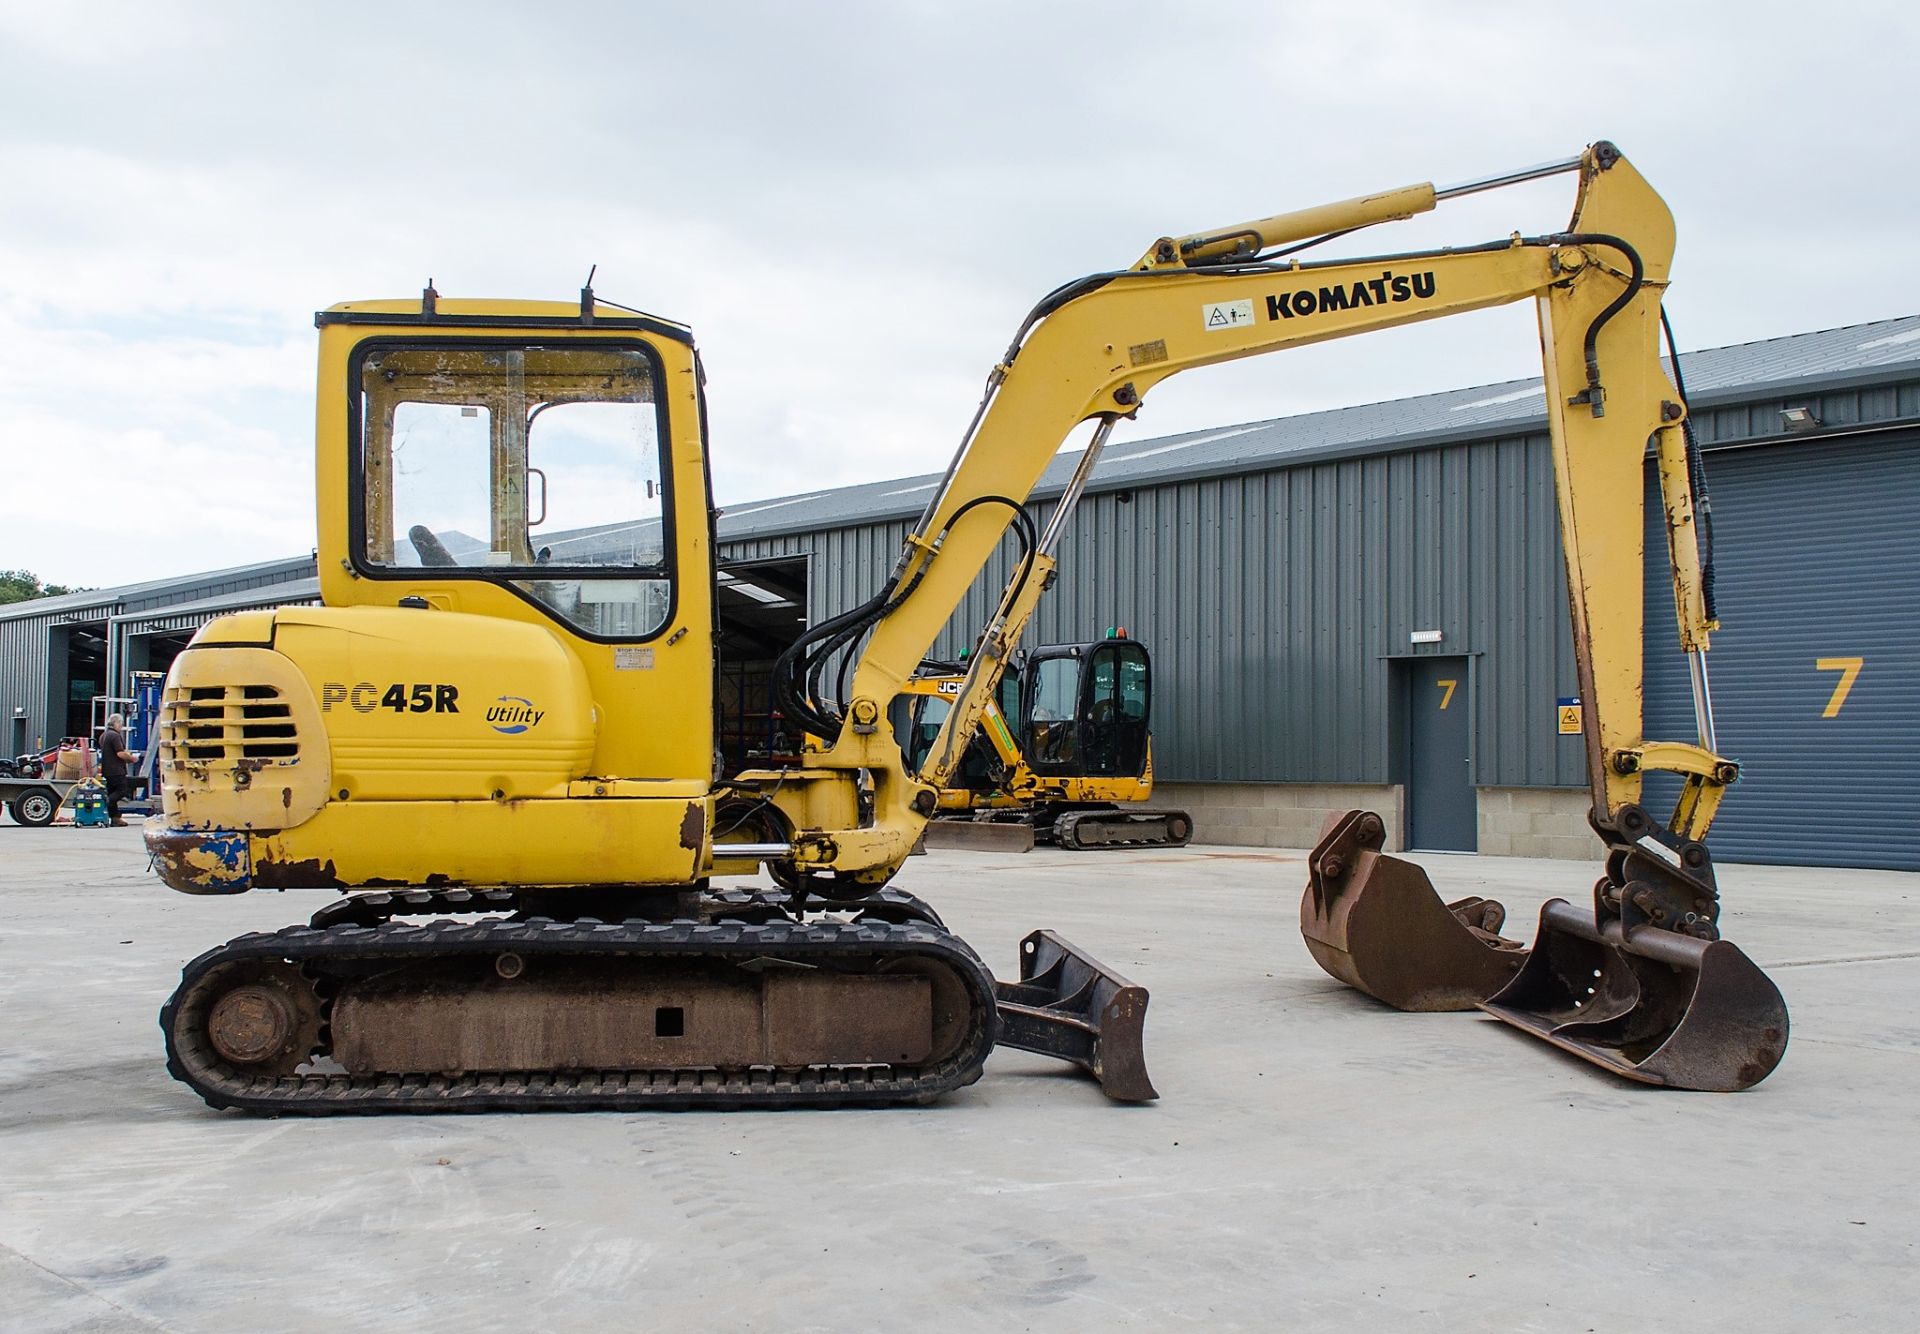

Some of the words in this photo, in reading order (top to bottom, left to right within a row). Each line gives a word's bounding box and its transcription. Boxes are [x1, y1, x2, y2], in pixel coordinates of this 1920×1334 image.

[1266, 271, 1436, 321] KOMATSU
[1437, 680, 1457, 710] 7
[1816, 657, 1864, 718] 7
[486, 706, 545, 727] Utility
